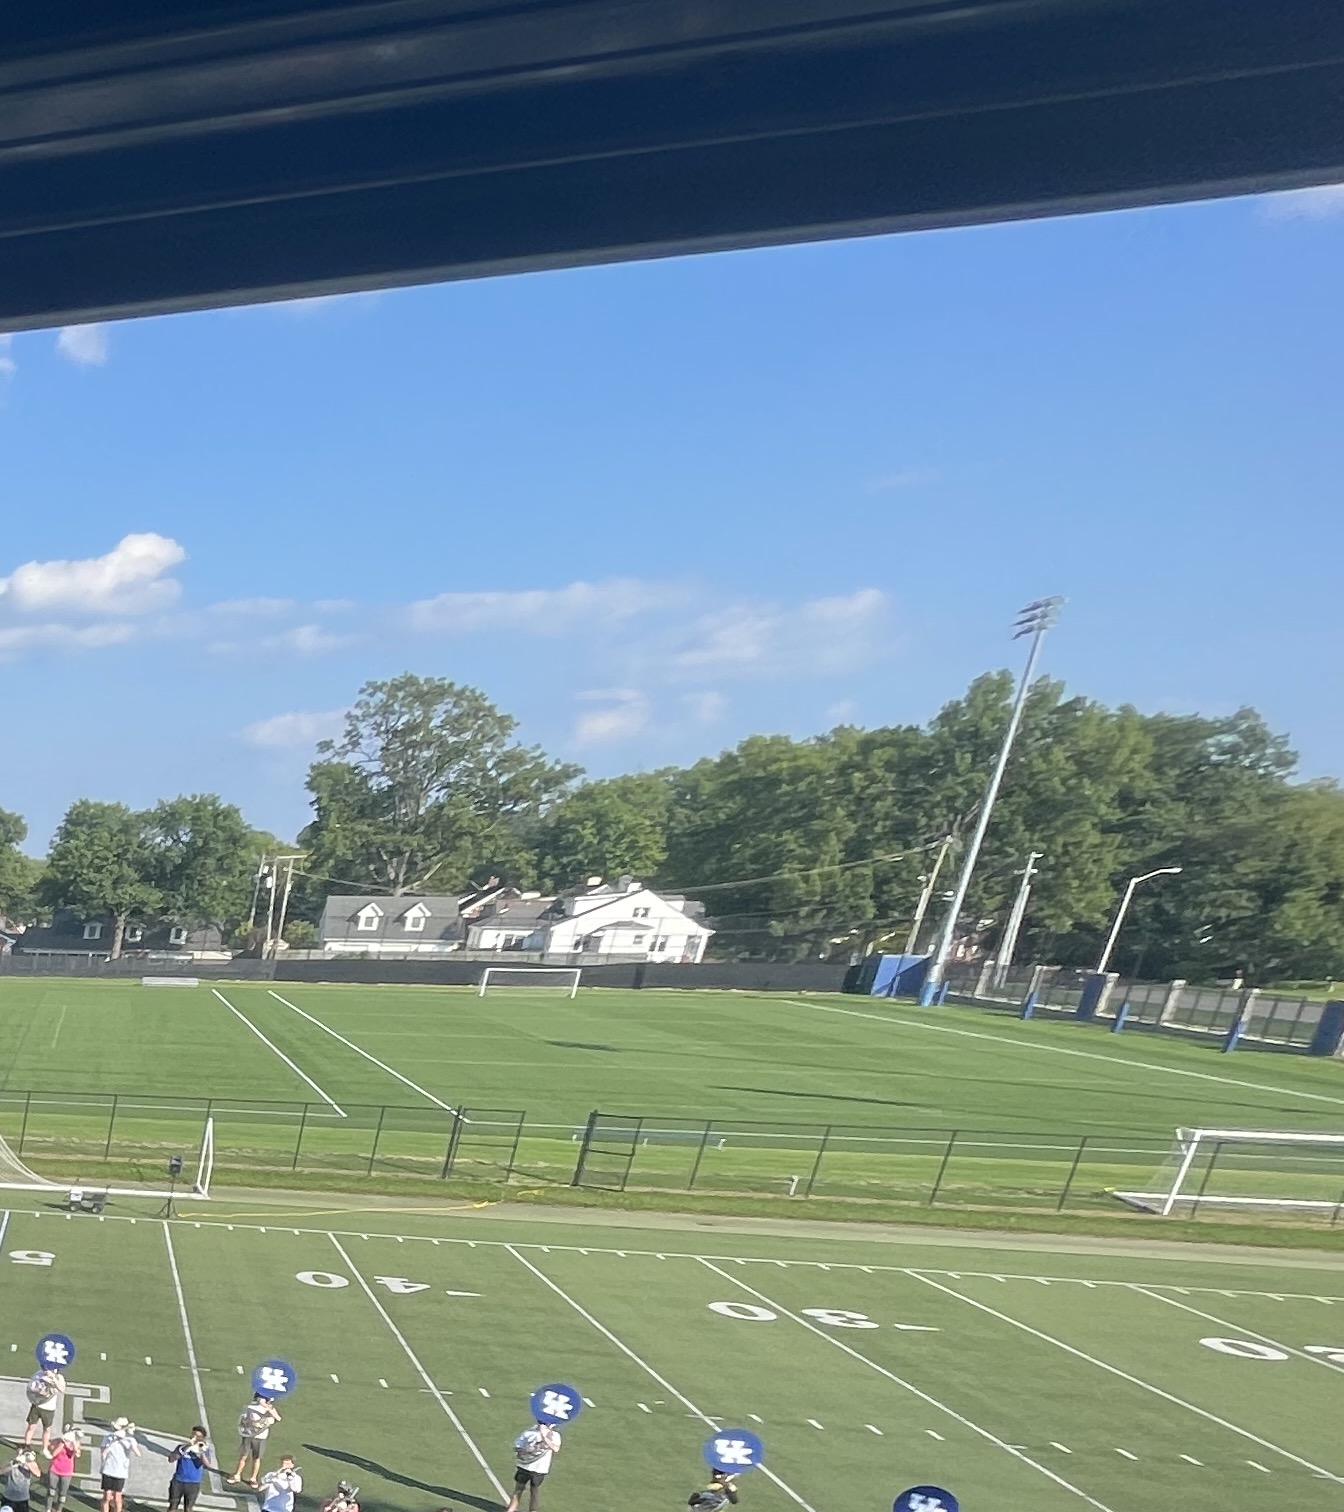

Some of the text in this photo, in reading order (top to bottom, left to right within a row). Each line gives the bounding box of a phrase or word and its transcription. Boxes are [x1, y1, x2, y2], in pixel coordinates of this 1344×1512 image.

[45, 1341, 68, 1364] UK
[260, 1367, 288, 1392] UK
[543, 1391, 573, 1419] UK
[714, 1439, 752, 1464] UK
